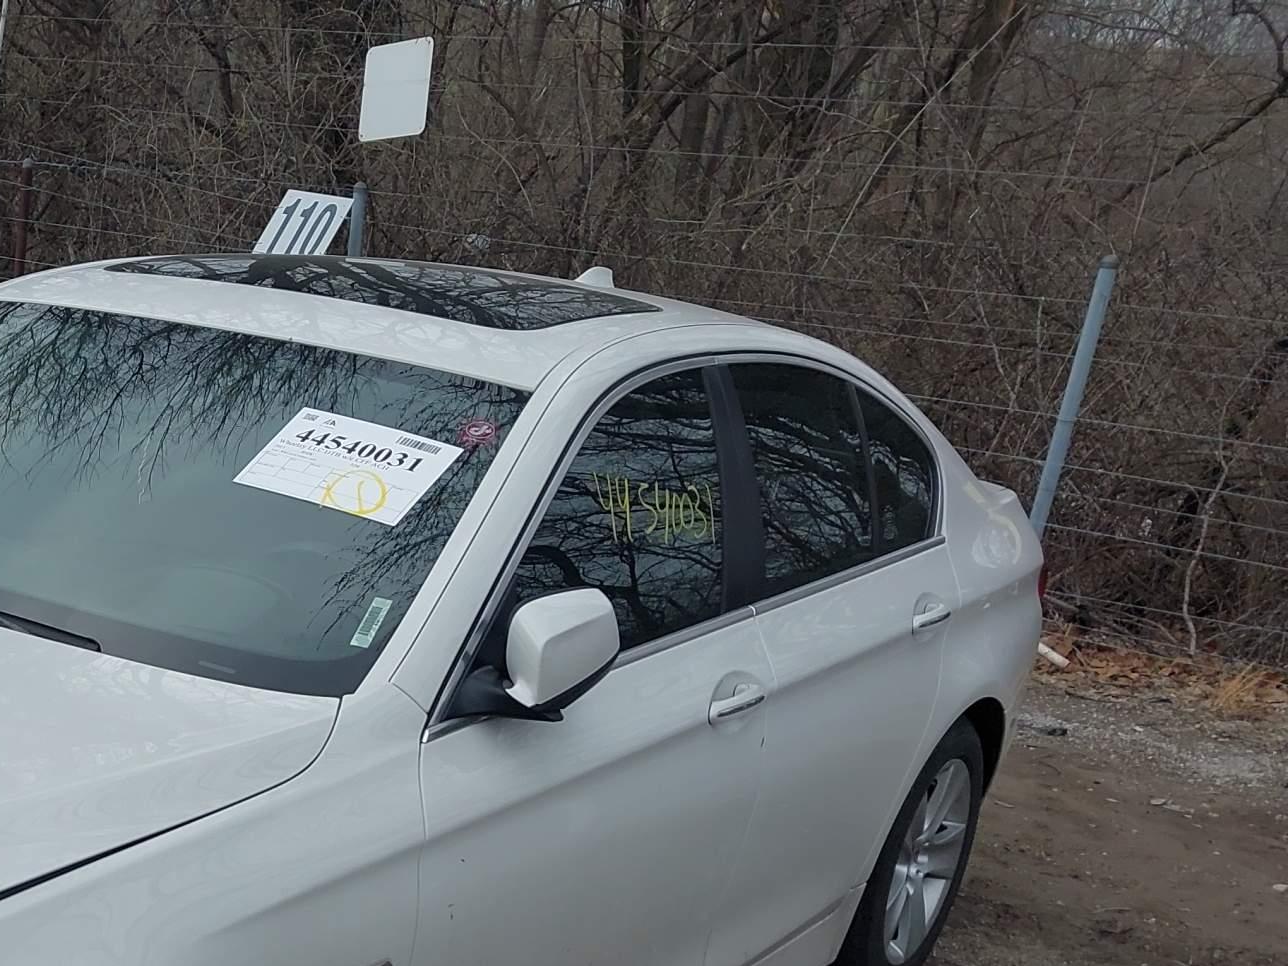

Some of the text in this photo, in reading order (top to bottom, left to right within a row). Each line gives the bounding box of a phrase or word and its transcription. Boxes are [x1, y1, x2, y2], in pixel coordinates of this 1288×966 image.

[265, 198, 338, 254] 110
[295, 429, 423, 472] 44540031
[592, 471, 715, 544] 44540031
